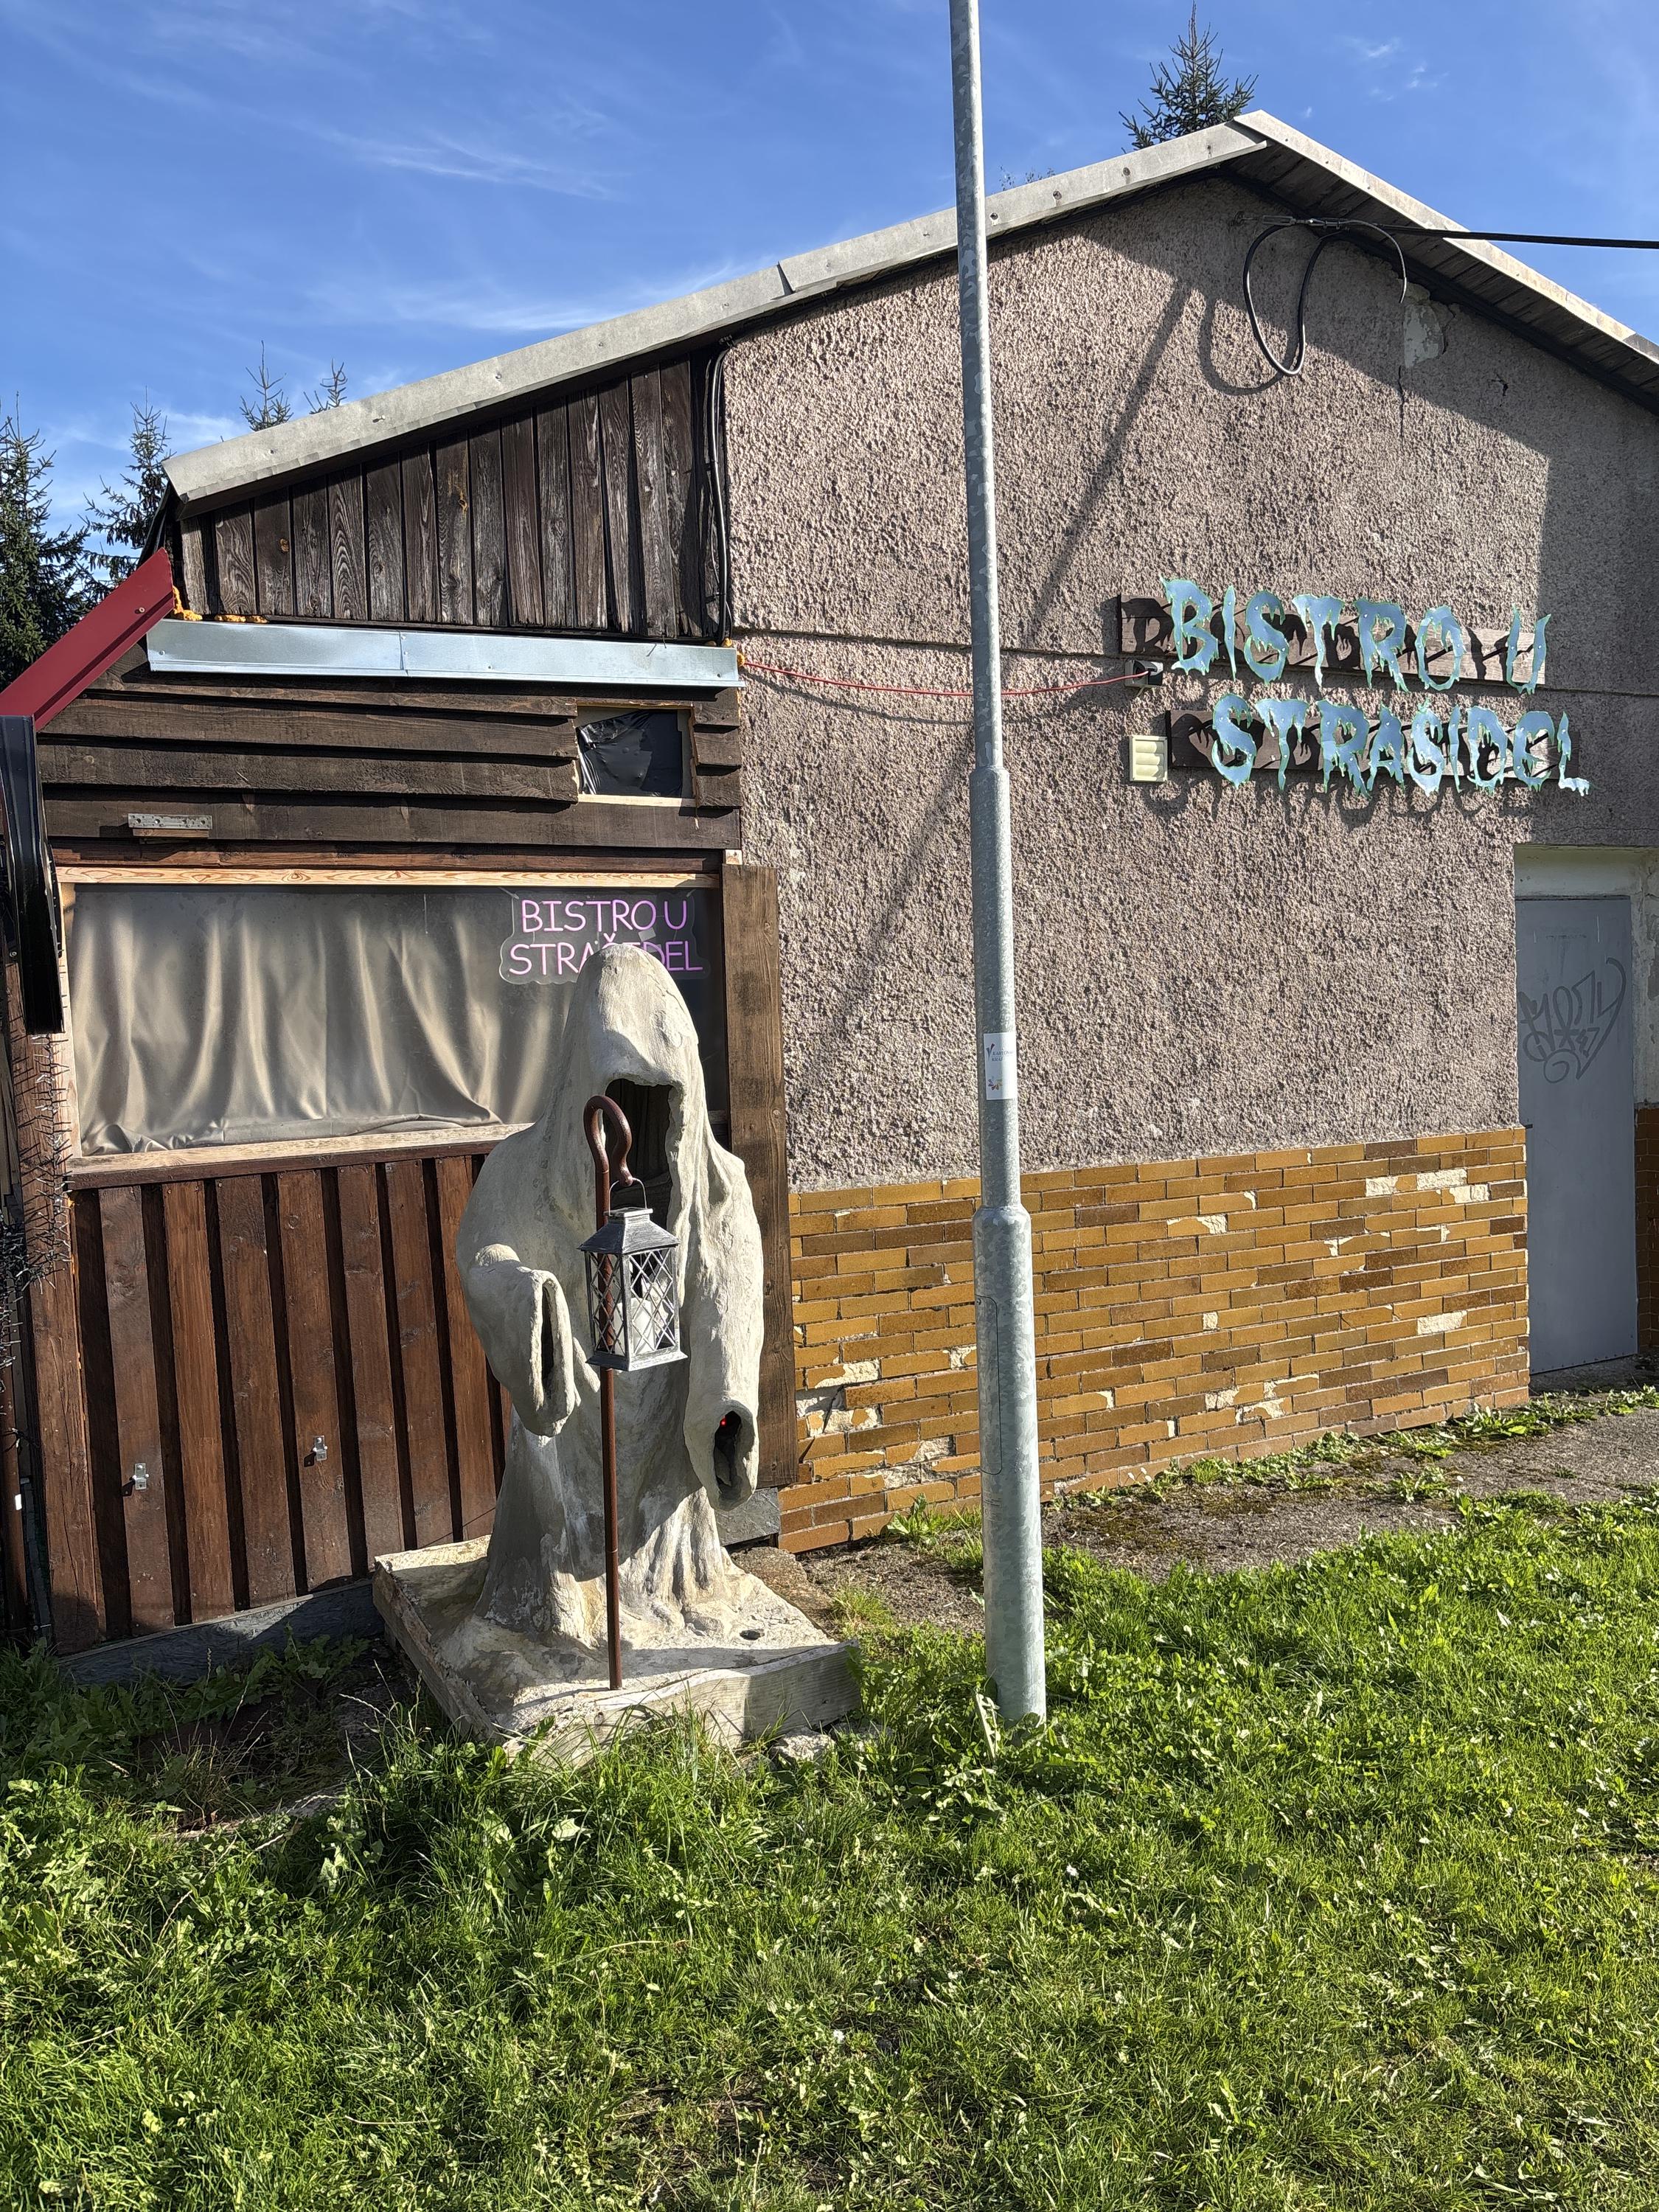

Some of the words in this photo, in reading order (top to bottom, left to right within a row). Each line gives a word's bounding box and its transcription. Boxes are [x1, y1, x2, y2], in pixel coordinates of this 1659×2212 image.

[1159, 574, 1467, 692] BISTRO
[1505, 603, 1551, 695] U
[521, 899, 658, 933] BISTRO
[664, 900, 687, 931] U
[509, 932, 704, 975] STRADEL
